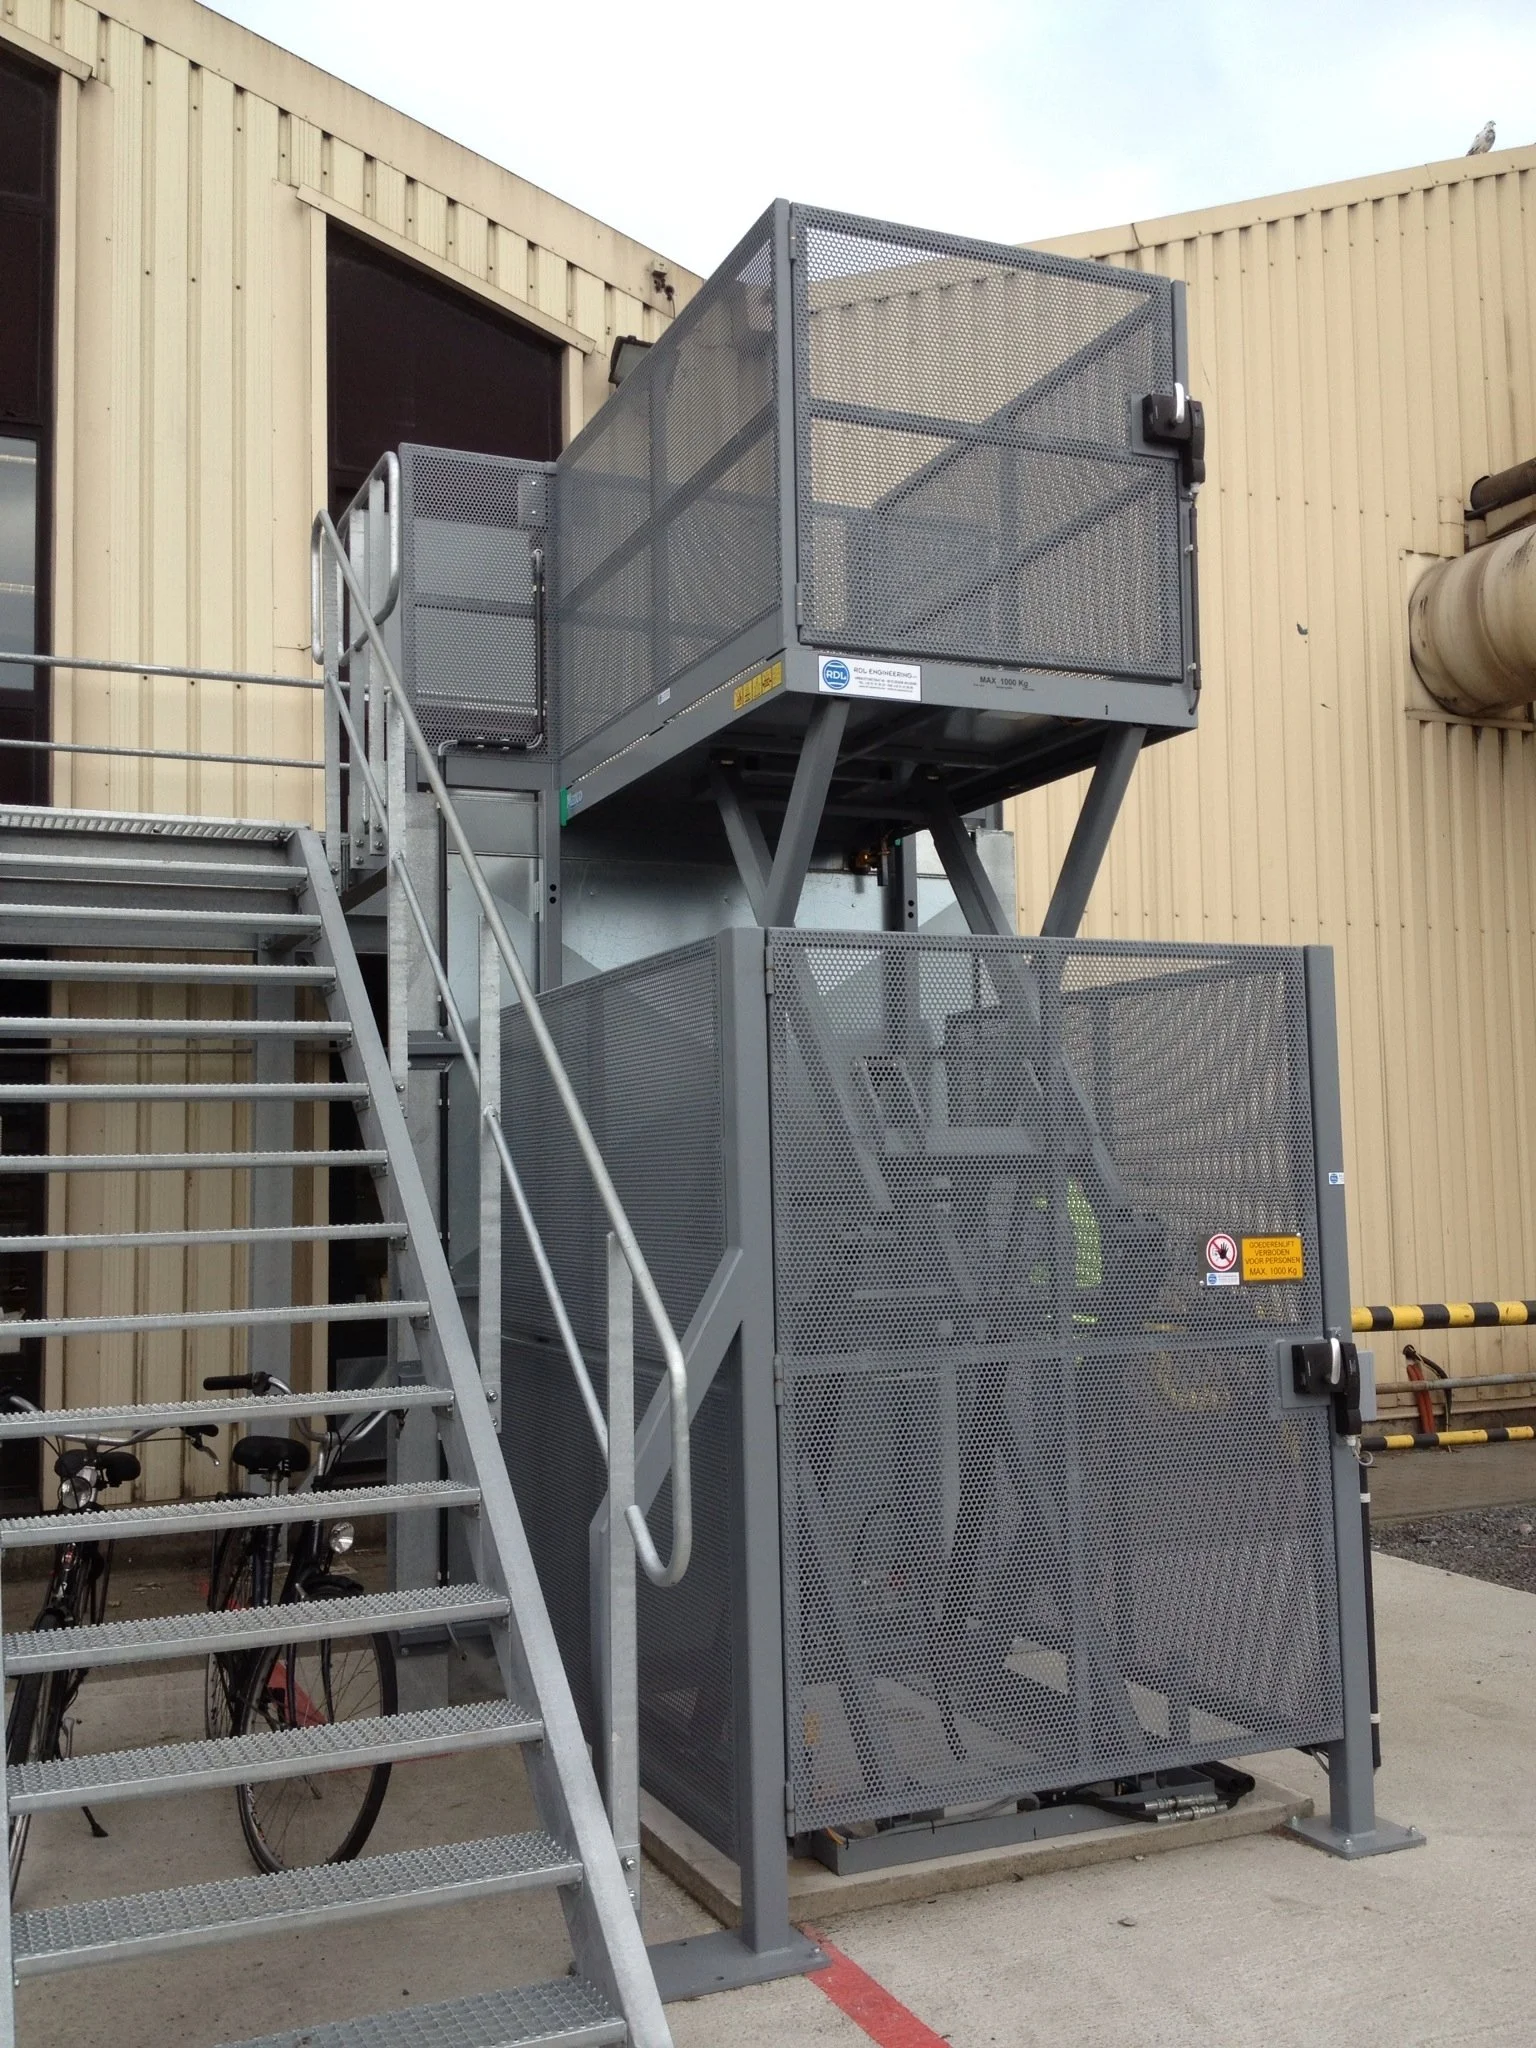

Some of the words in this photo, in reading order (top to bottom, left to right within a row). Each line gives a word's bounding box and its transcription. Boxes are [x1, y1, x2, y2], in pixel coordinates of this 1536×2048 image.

[826, 670, 847, 680] RDL
[868, 668, 913, 679] ENGINEERING
[1001, 677, 1017, 686] 1000
[1018, 679, 1029, 688] Kg
[1245, 1257, 1264, 1265] VOOR
[1265, 1256, 1301, 1264] PERSONEN
[1270, 1266, 1287, 1275] 1000
[1287, 1266, 1298, 1276] Kg
